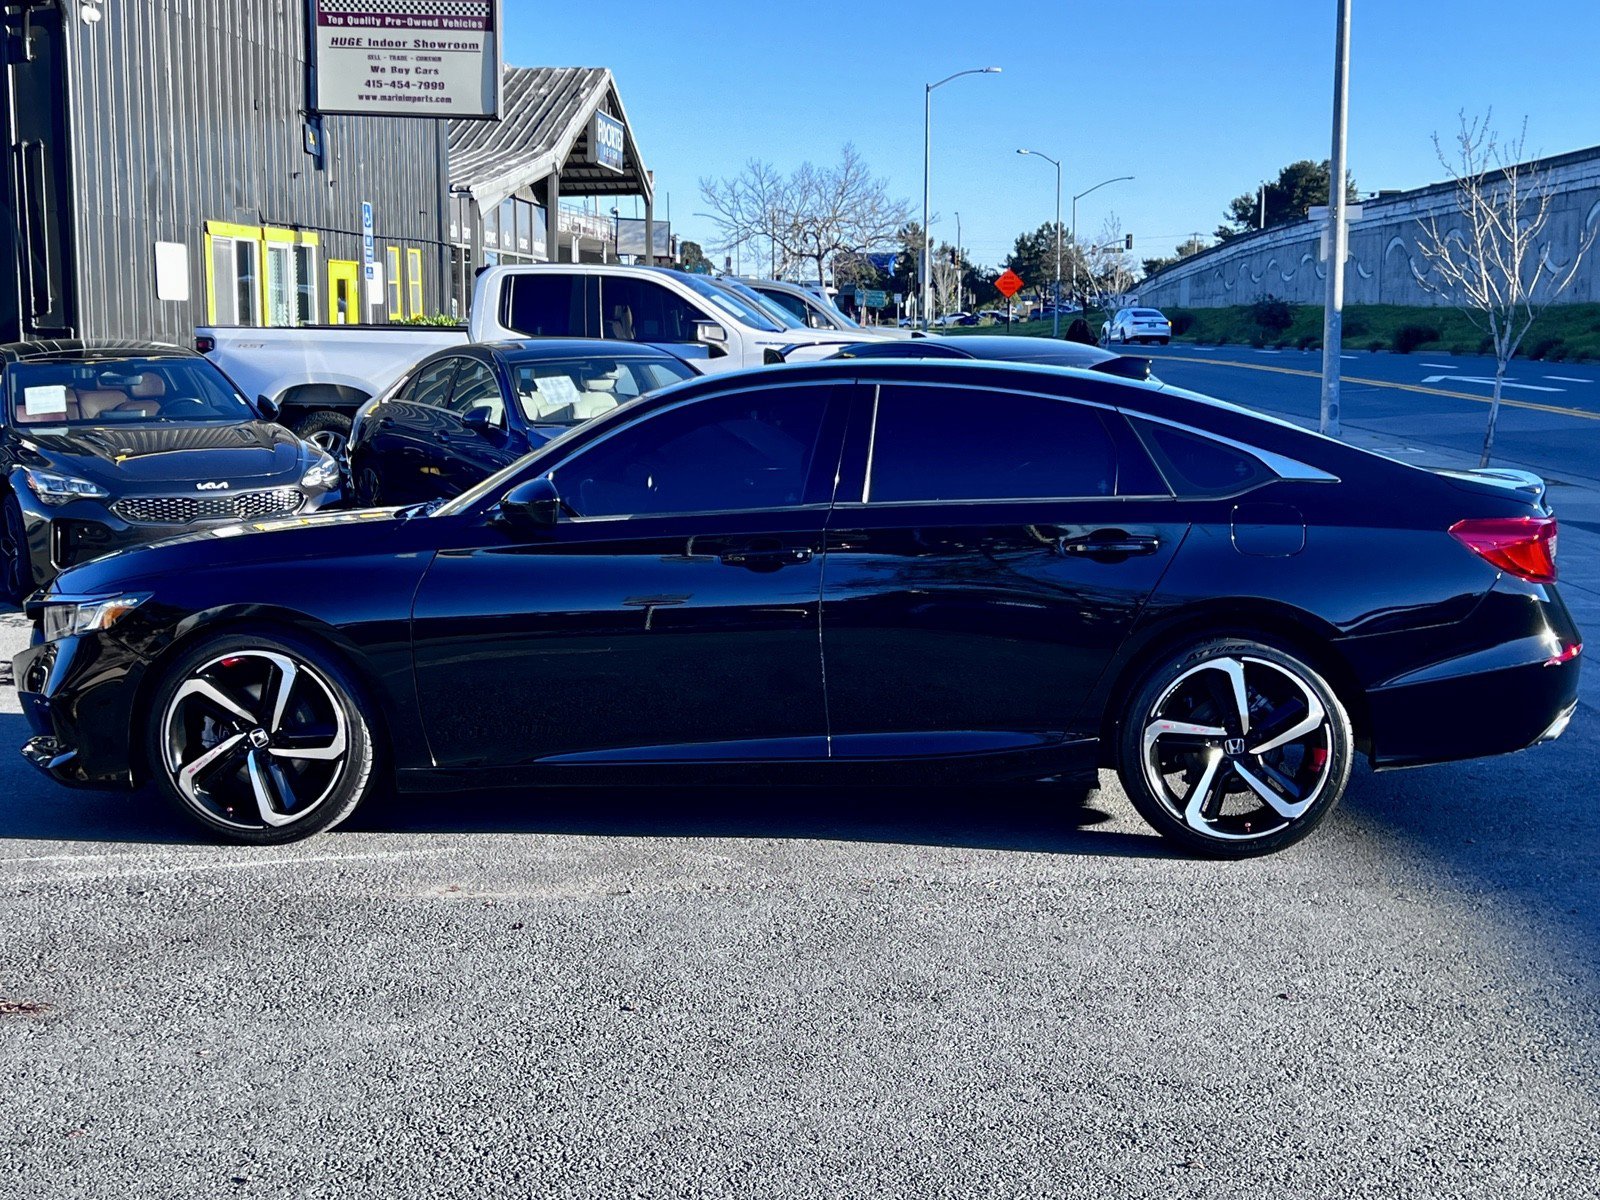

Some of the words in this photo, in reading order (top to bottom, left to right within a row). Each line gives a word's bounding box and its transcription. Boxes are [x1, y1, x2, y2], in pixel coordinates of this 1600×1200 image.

[326, 14, 344, 26] Top
[347, 14, 381, 27] Quality
[385, 16, 439, 28] Pre-Owned
[442, 18, 483, 29] Vehicles
[330, 37, 363, 47] HUGE
[368, 38, 408, 48] Indoor
[413, 39, 480, 50] Showroom
[370, 65, 386, 74] We
[390, 66, 410, 75] Buy
[415, 67, 439, 75] Cars
[364, 80, 445, 91] 415-454-7999
[358, 92, 452, 104] www.marinimports.com
[1184, 645, 1246, 664] ATTURO
